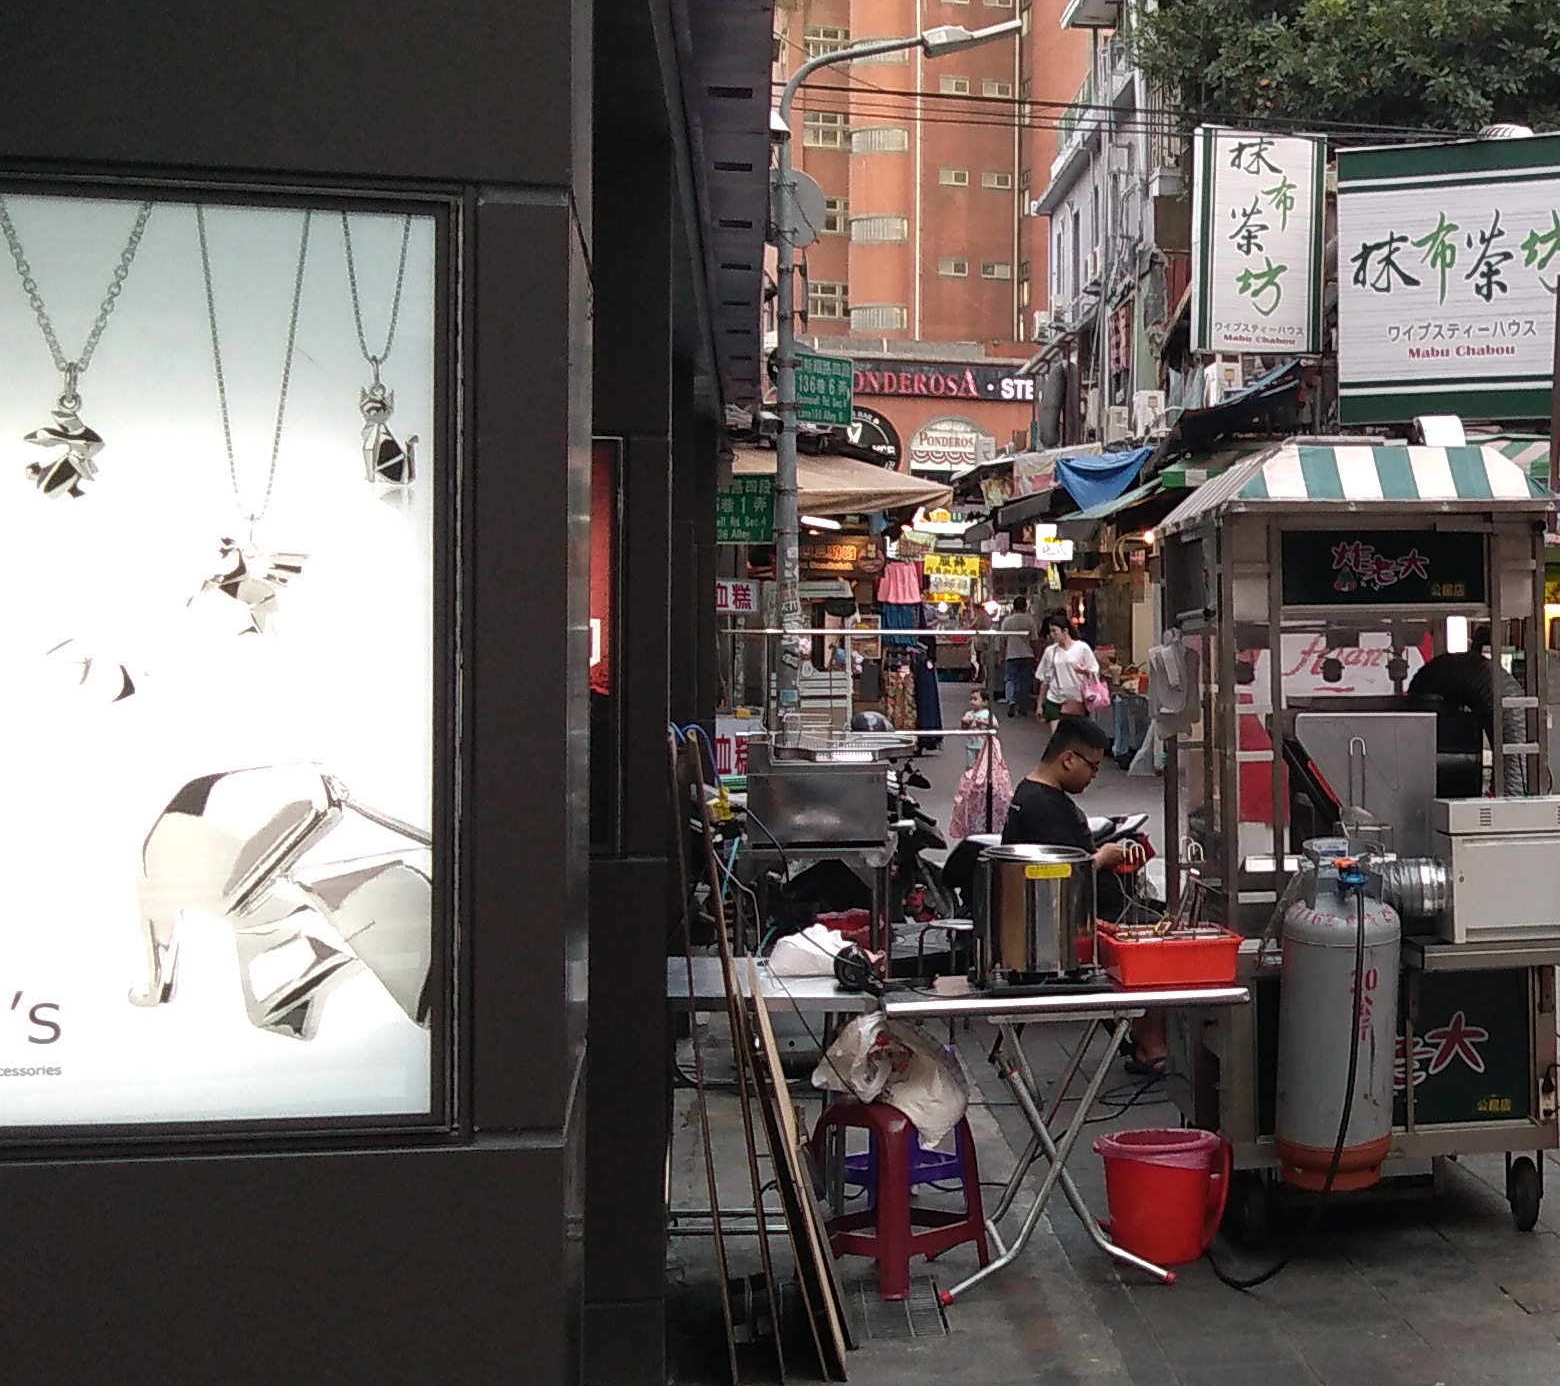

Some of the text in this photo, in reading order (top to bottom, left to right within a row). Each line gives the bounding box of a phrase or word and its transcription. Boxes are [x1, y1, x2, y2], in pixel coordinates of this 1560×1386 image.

[1229, 138, 1297, 318] 抹布茶坊
[1386, 318, 1538, 344] ワイプスティーハウス
[1407, 343, 1516, 361] Mabu Chabou
